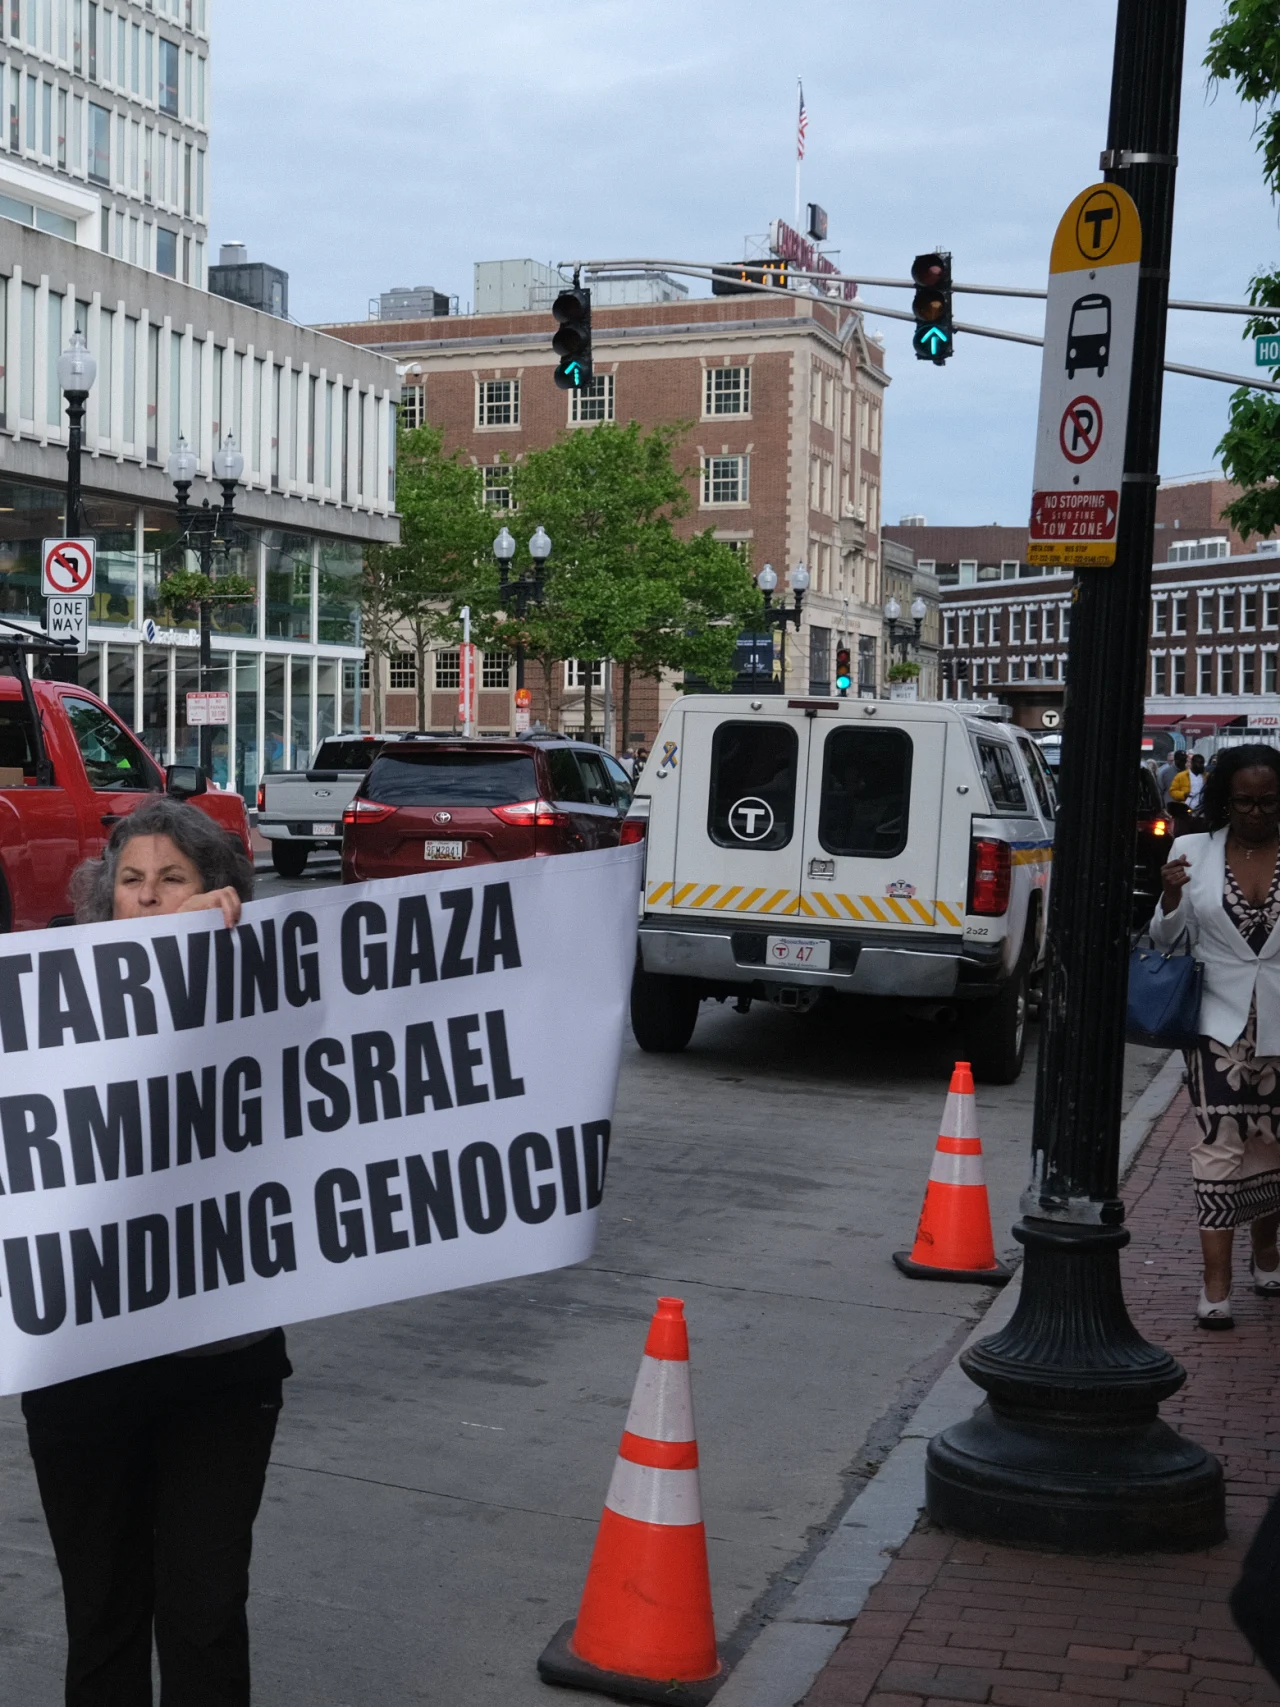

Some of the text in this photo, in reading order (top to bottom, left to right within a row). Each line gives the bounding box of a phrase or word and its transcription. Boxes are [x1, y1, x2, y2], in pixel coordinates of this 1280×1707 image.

[1260, 342, 1280, 360] HO
[1044, 494, 1105, 508] NO STOPPING
[1075, 511, 1095, 519] FINE
[1042, 522, 1103, 536] TOW ZONE
[53, 602, 82, 615] ONE
[52, 618, 83, 631] WAY
[1258, 716, 1278, 726] PIZZA
[738, 807, 765, 834] T
[340, 882, 522, 996] GAZA
[796, 946, 814, 961] 47
[281, 1009, 525, 1140] ISRAEL
[313, 1118, 611, 1264] GENOCID
